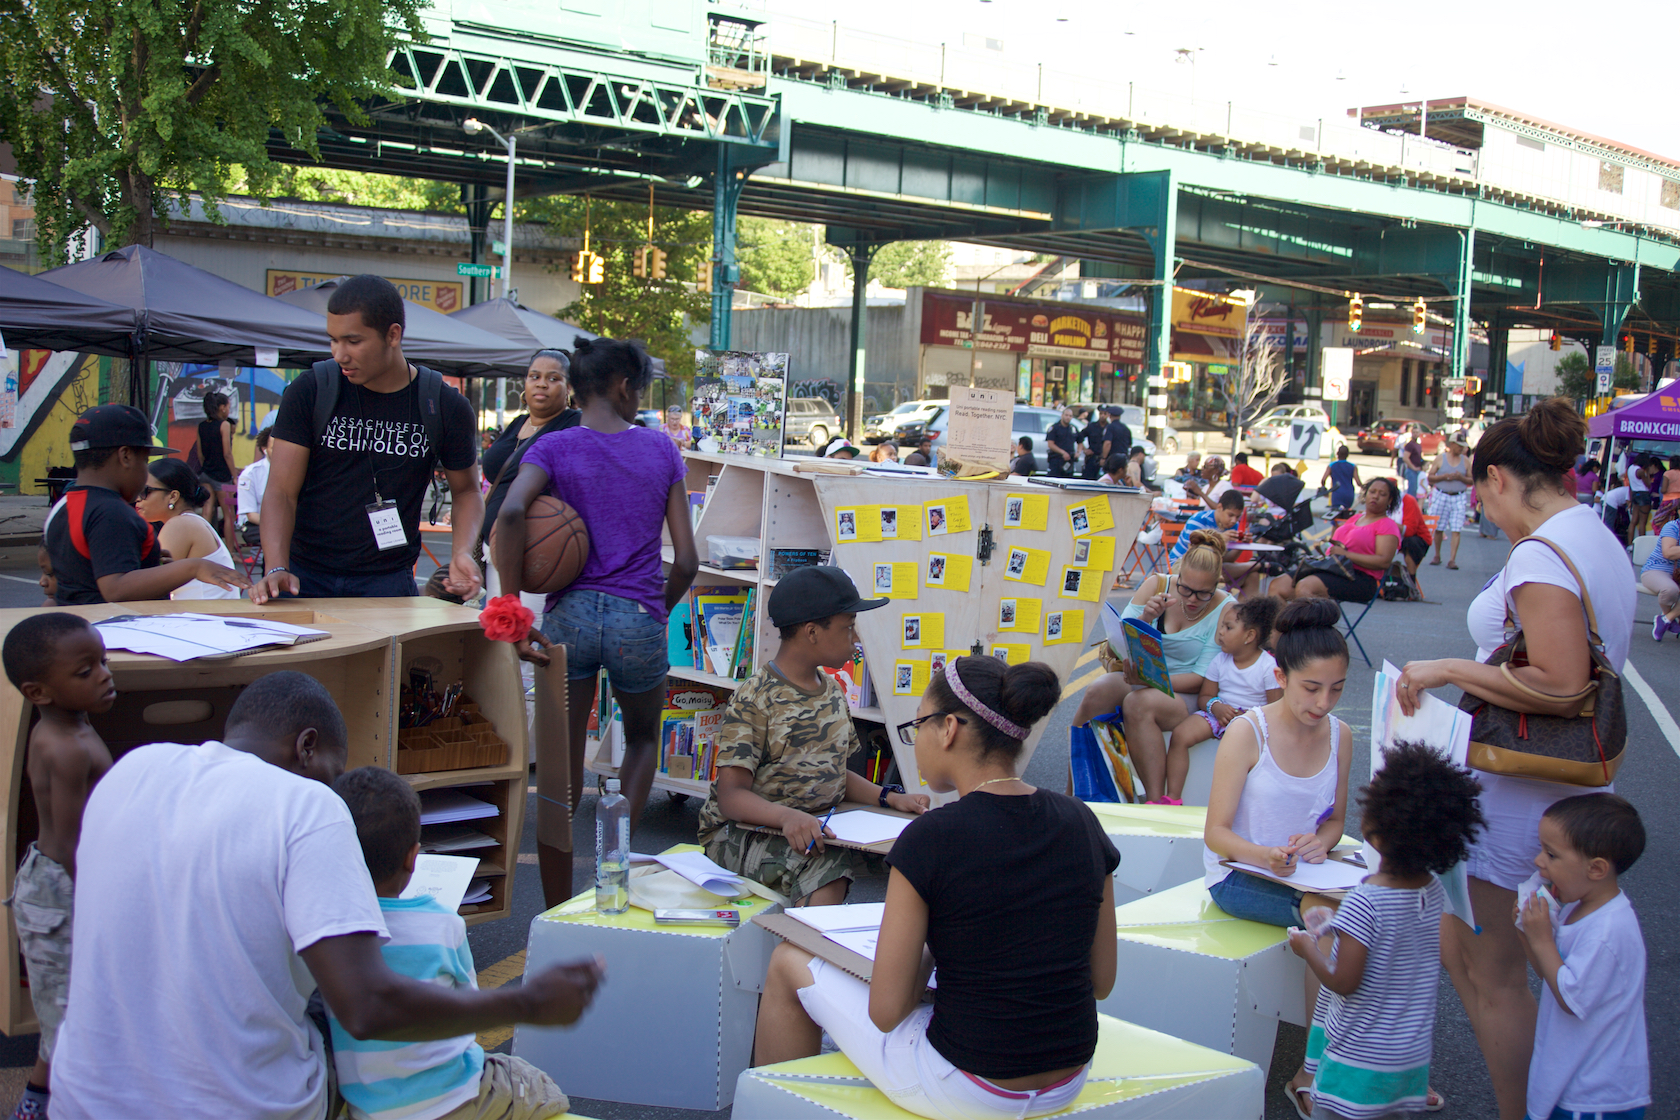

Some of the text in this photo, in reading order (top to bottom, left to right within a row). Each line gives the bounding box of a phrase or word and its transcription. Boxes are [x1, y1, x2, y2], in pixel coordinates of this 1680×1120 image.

[458, 264, 490, 277] Southern
[1030, 331, 1048, 344] DELI
[1054, 333, 1087, 348] PAULINO
[1342, 337, 1398, 350] LAUNDROMAT
[1598, 357, 1612, 366] 25
[331, 416, 425, 433] ASSACHUSETT
[326, 424, 405, 444] NSTITUTE
[688, 696, 712, 706] Maisy
[699, 713, 722, 727] HOP
